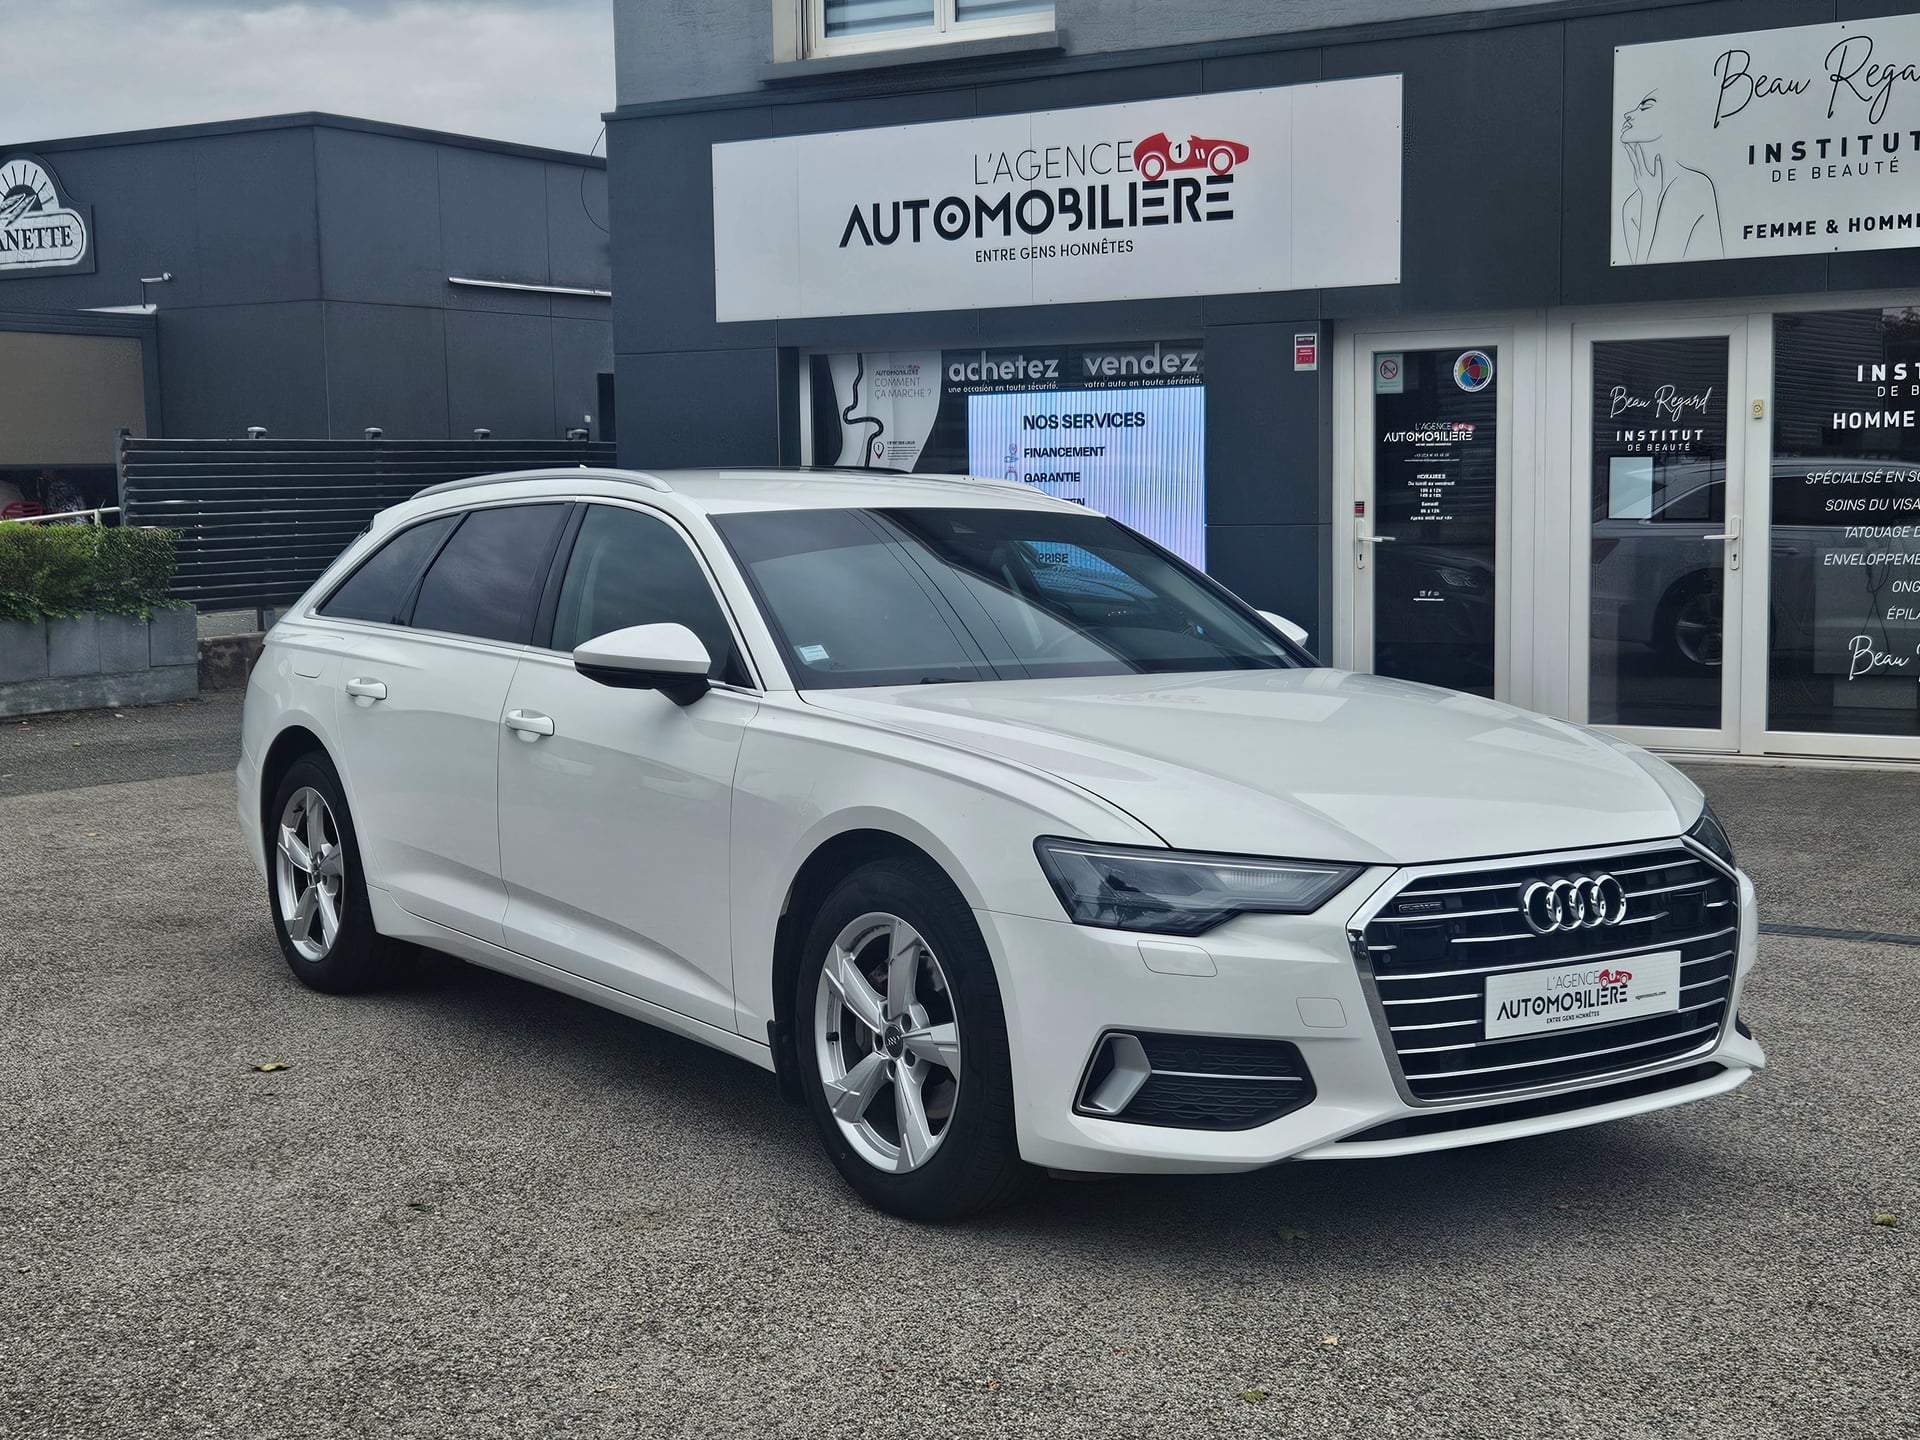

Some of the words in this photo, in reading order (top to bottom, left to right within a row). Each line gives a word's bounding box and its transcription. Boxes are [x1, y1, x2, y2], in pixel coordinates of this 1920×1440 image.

[1713, 48, 1811, 129] Beau
[1748, 130, 1920, 165] INSTITUT
[974, 140, 1134, 186] L'AGENCE
[1771, 168, 1797, 183] DE
[1811, 156, 1900, 180] BEAUTÉ
[1743, 220, 1817, 240] FEMME
[1825, 219, 1839, 234] &
[975, 245, 1017, 263] ENTRE
[1019, 243, 1056, 260] GENS
[1059, 237, 1134, 257] HONNÊTES
[948, 350, 1060, 382] achetez
[1083, 342, 1199, 377] vendez
[874, 377, 920, 388] COMMENT
[963, 383, 994, 392] occasion
[1006, 383, 1026, 392] toute
[1107, 380, 1127, 388] auto
[1877, 385, 1899, 397] DE
[888, 388, 925, 398] MARCHE
[1609, 385, 1651, 419] Beau
[1654, 384, 1713, 423] Regard
[1023, 414, 1059, 431] NOS
[1061, 411, 1146, 430] SERVICES
[1832, 410, 1916, 430] HOMME
[1616, 429, 1704, 442] INSTITUT
[1023, 446, 1105, 459] FINANCEMENT
[1627, 443, 1641, 452] DE
[1647, 441, 1691, 452] BEAUTÉ
[1023, 471, 1081, 483] GARANTIE
[1805, 468, 1883, 485] SPÉCIALISÉ
[1885, 471, 1905, 483] EN
[1825, 498, 1866, 512] SOINS
[1868, 498, 1889, 512] DU
[1844, 525, 1911, 538] TATOUAGE
[1848, 634, 1910, 681] Beau
[1546, 970, 1600, 991] L'AGENCE
